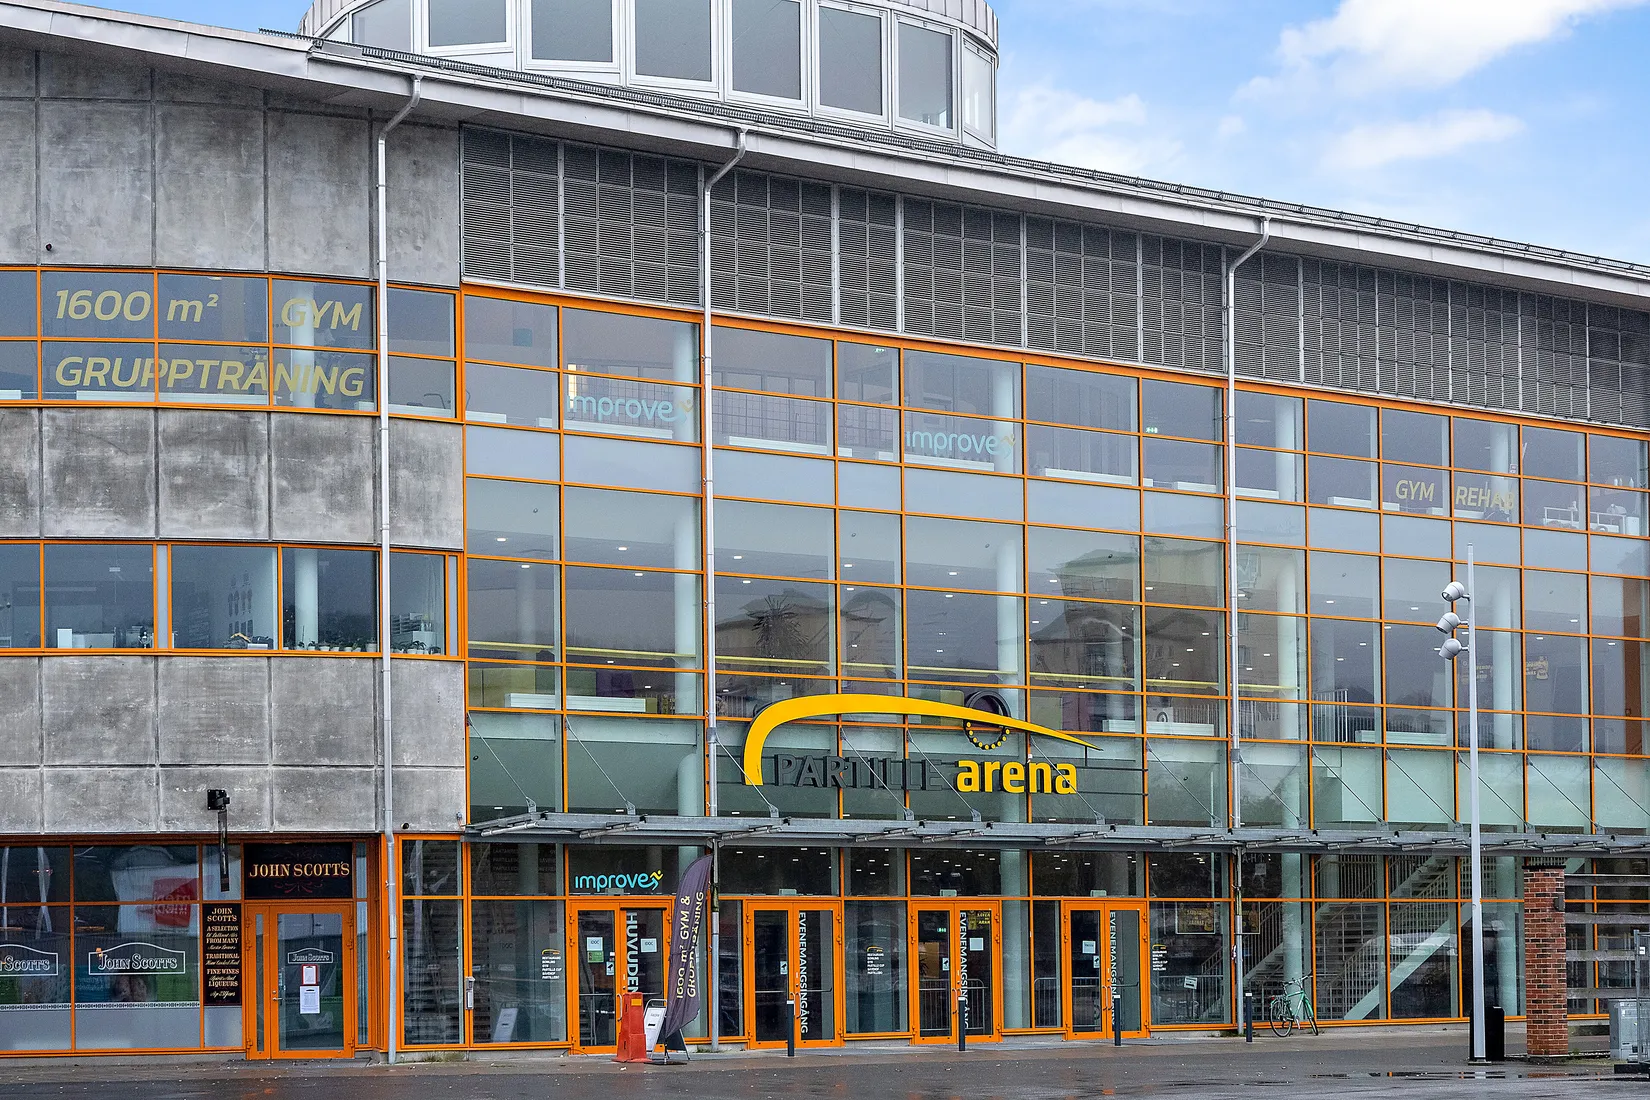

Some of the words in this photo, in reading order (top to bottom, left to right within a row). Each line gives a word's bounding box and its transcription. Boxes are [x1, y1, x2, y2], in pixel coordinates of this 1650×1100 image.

[55, 289, 151, 321] 1600
[166, 294, 218, 322] m²
[280, 298, 363, 331] GYM
[55, 355, 365, 396] GRUPPTRÄNING
[568, 393, 678, 422] improve
[905, 430, 1000, 455] improve
[1395, 479, 1435, 502] GYM
[1456, 484, 1516, 508] REHAB
[774, 753, 944, 792] PARTILLE
[956, 758, 1077, 794] arena
[249, 863, 290, 877] JOHN
[293, 861, 350, 877] SCOTT'S
[575, 872, 654, 893] improve
[211, 907, 233, 915] JOHN
[681, 895, 691, 906] &
[207, 914, 237, 922] SCOTT'S
[680, 911, 690, 940] GYM
[4, 955, 50, 972] SCOTT'S
[98, 954, 130, 970] JOHN
[132, 953, 177, 970] SCOTT'S
[799, 912, 810, 1034] EVENEMANGSINGÅNG
[676, 967, 686, 999] 1600
